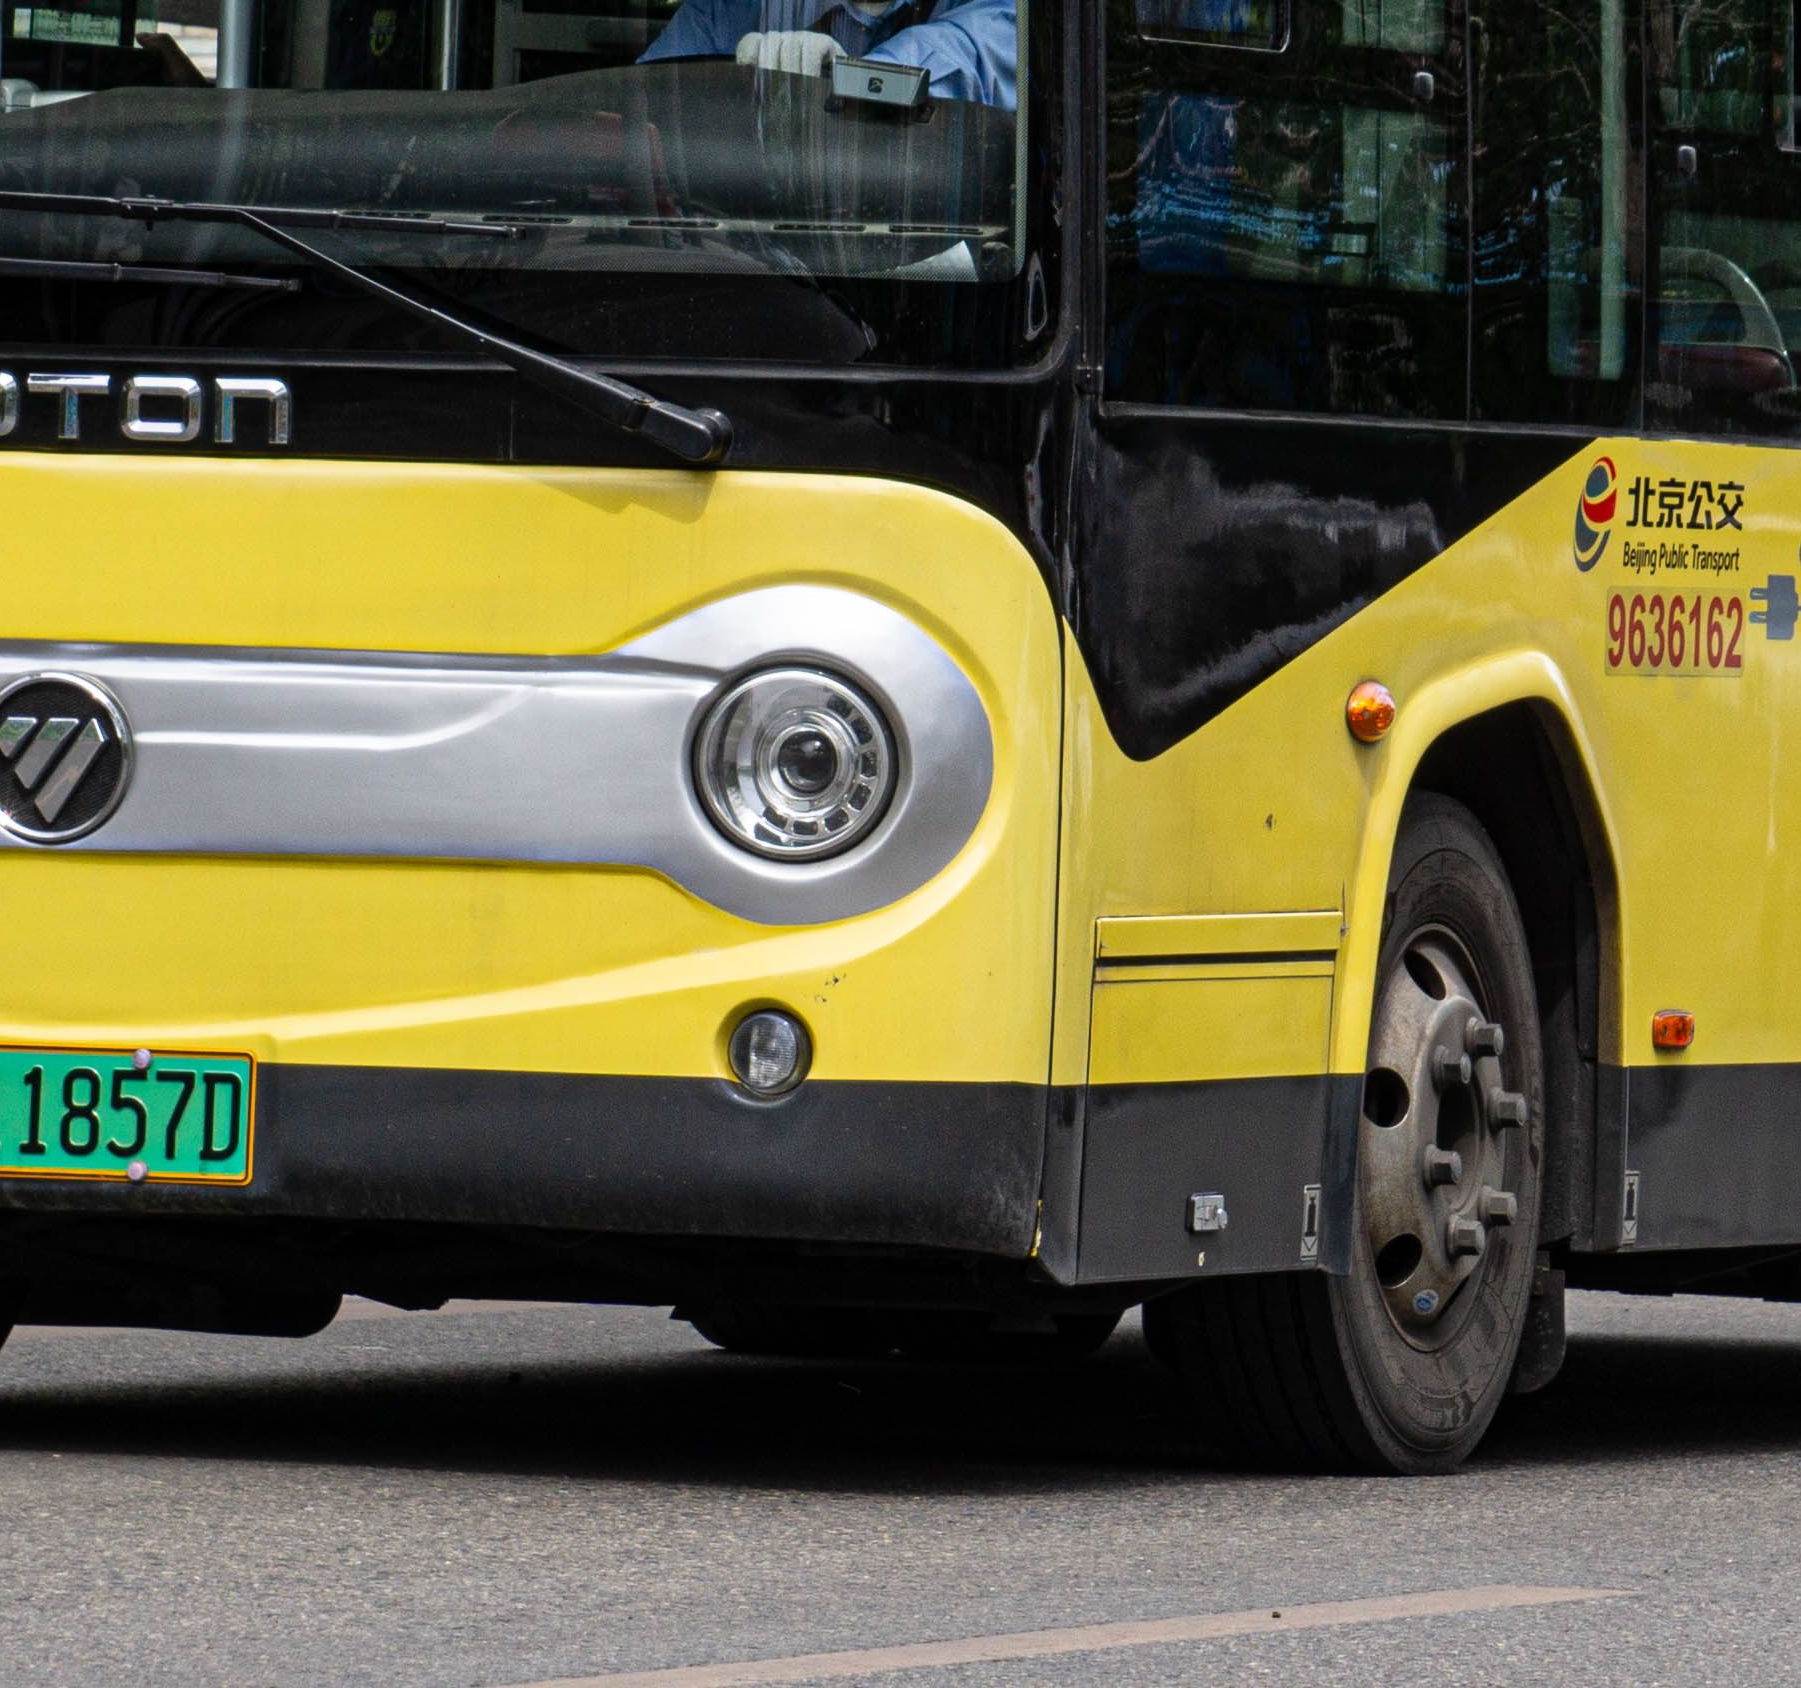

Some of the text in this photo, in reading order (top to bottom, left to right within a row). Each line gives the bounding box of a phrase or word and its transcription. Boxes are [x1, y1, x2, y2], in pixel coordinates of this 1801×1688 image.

[1626, 476, 1745, 531] 北京公交
[1622, 541, 1740, 576] Beijing Public Transport
[1607, 593, 1744, 669] 9636162
